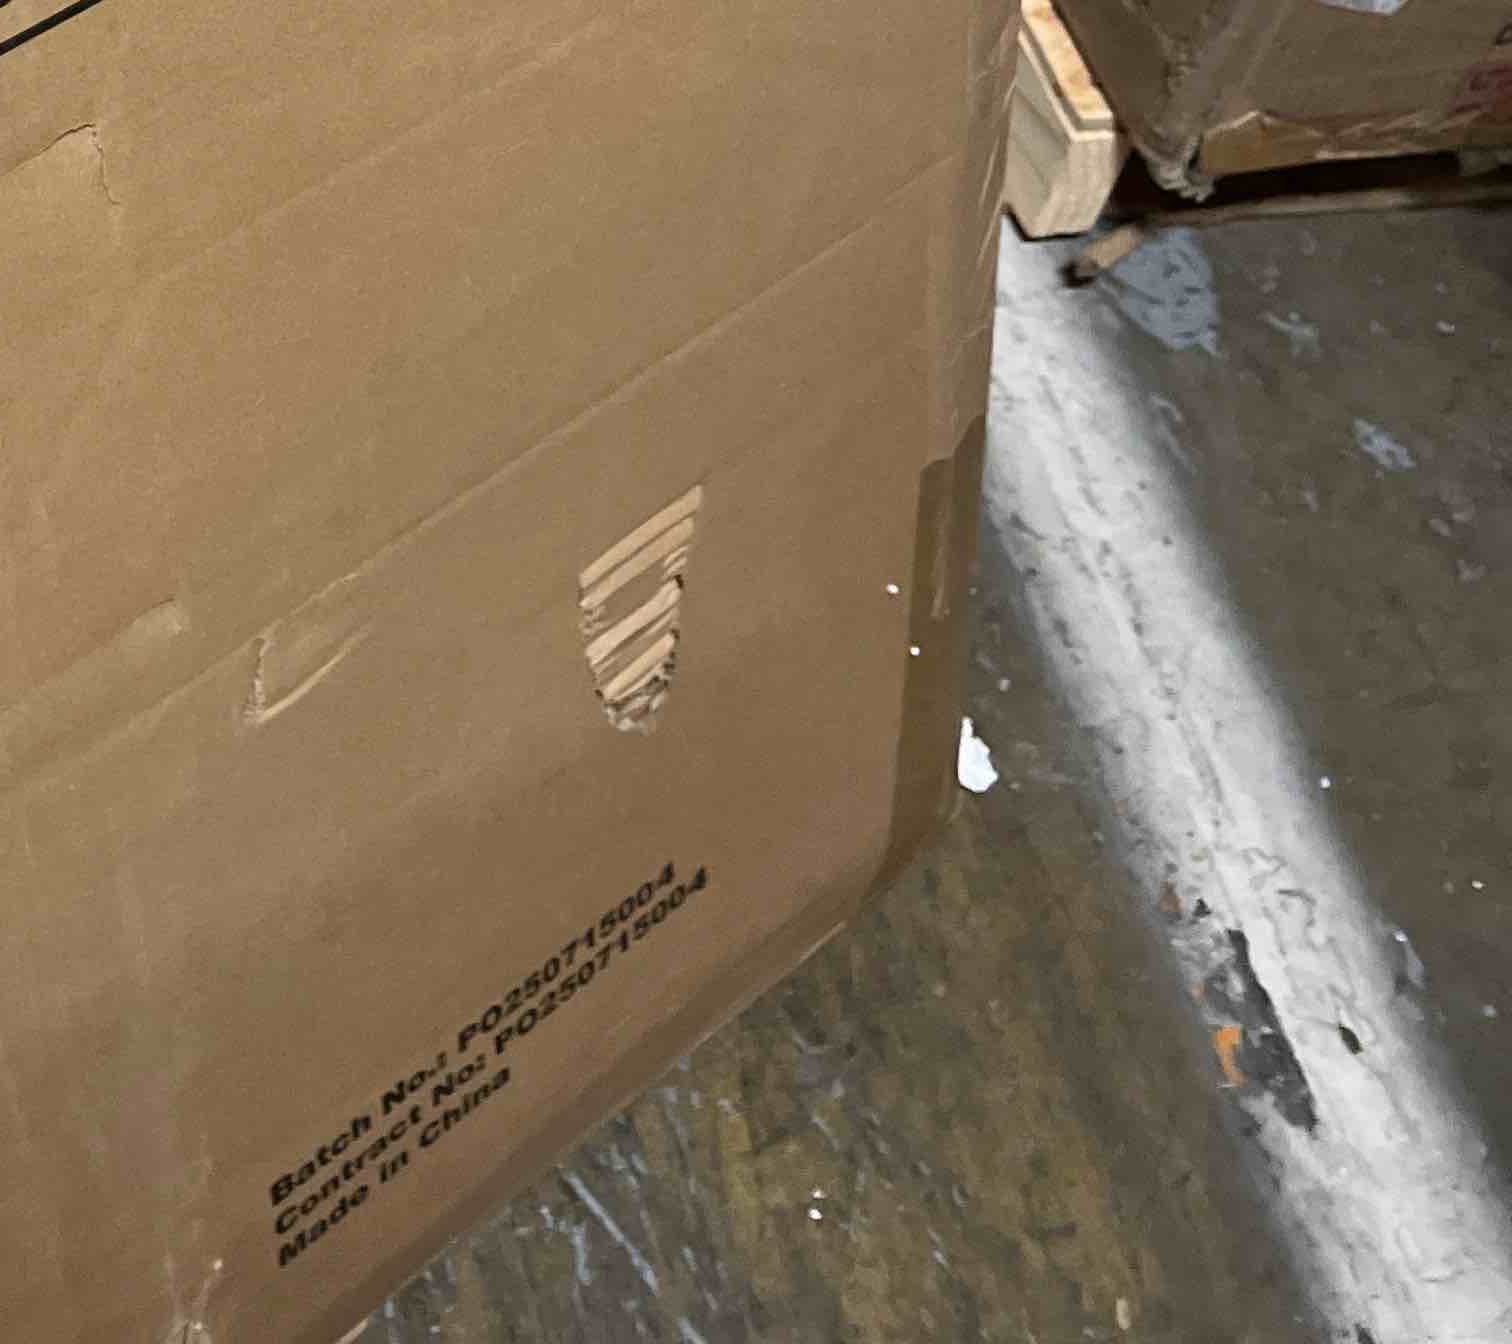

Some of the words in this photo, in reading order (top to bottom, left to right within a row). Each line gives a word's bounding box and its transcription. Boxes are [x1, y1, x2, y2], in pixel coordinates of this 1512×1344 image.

[271, 1115, 371, 1207] Batch
[457, 861, 675, 1052] PO250715004
[275, 1105, 422, 1234] Contract
[432, 1053, 487, 1106] No:
[494, 865, 707, 1055] PO250715004
[279, 1184, 369, 1269] Made
[380, 1150, 409, 1184] in
[418, 1067, 511, 1148] China
